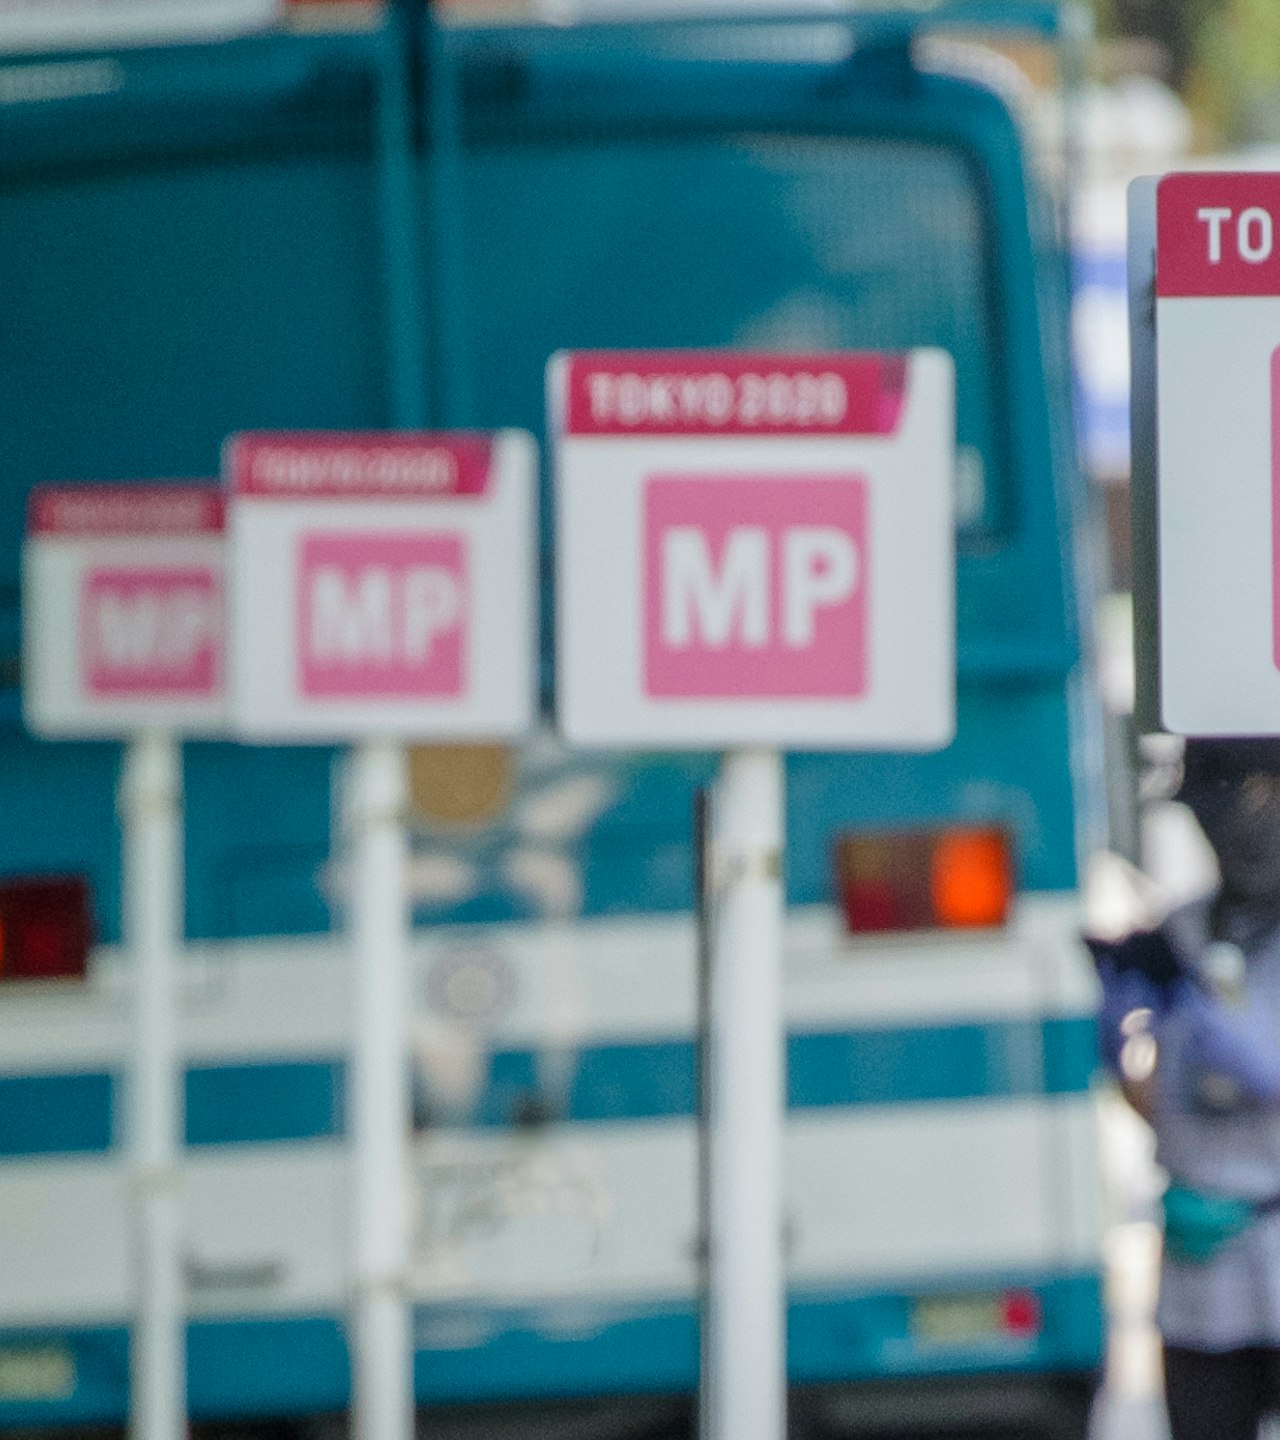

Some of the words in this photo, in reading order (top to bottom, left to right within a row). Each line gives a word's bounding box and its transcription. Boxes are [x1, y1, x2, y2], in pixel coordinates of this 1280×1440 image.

[587, 372, 732, 425] TOKYO
[738, 371, 847, 425] 2020
[313, 566, 460, 661] MP
[664, 525, 858, 647] MP
[102, 600, 217, 677] MP
